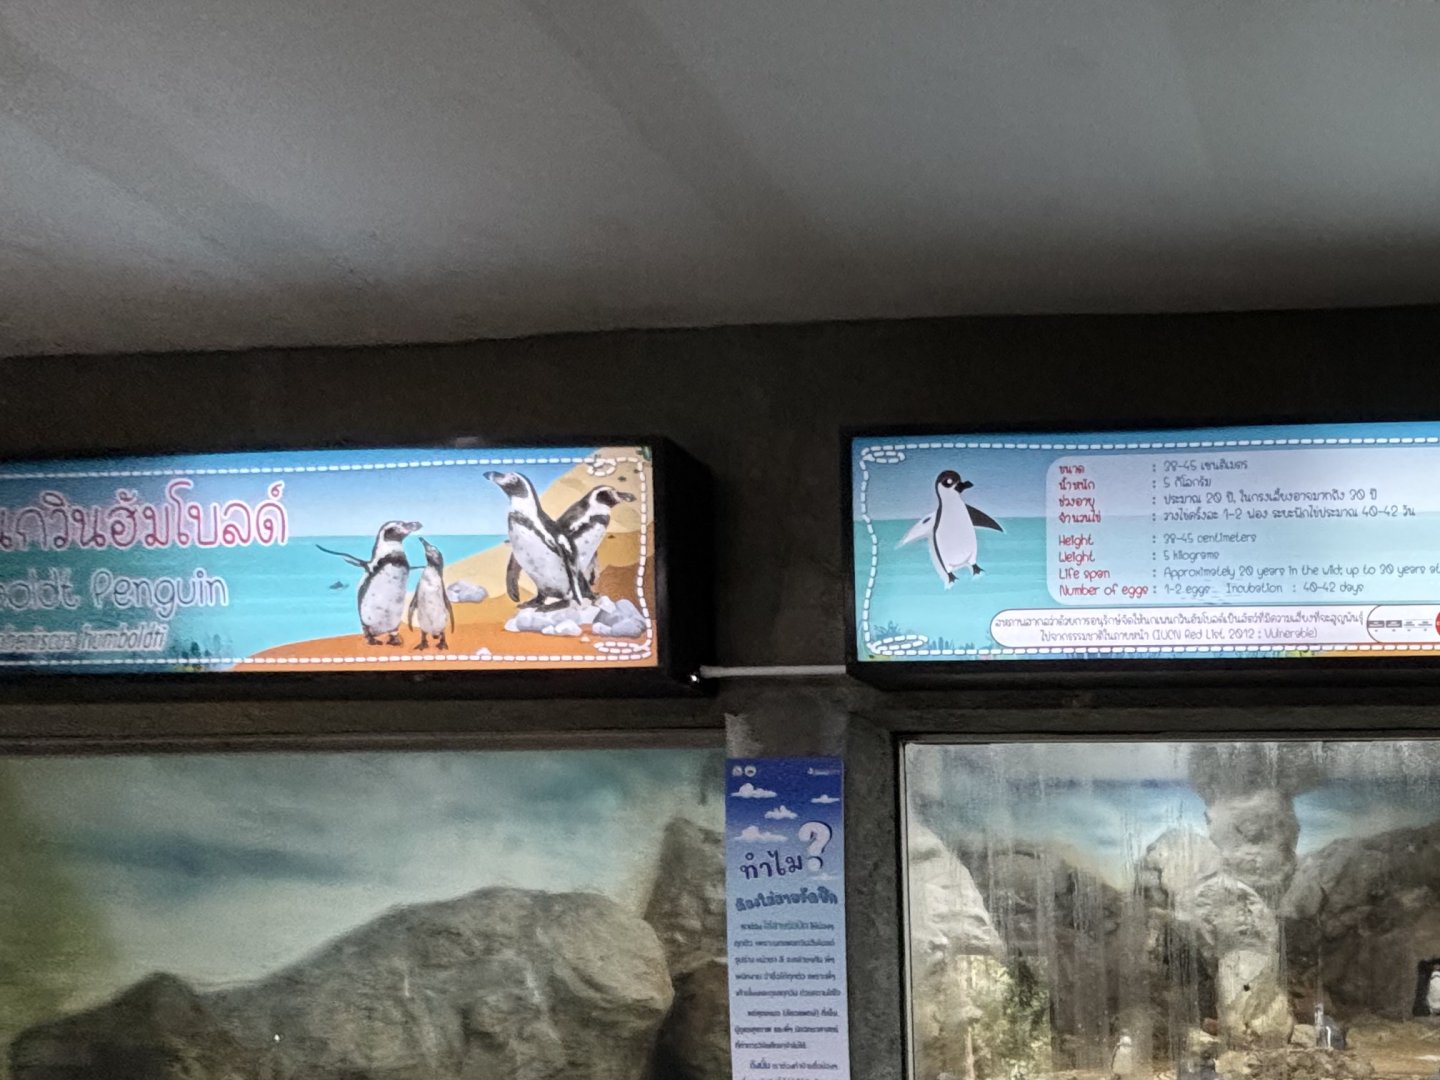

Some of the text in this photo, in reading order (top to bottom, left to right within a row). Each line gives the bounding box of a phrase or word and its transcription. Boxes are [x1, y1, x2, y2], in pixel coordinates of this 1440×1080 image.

[1163, 476, 1170, 488] 5
[1206, 492, 1222, 503] 20
[1224, 507, 1243, 519] 1-2
[1361, 505, 1398, 516] 40-42
[1058, 533, 1095, 549] Height
[1196, 531, 1257, 543] centimeters
[1058, 550, 1096, 566] Weight
[1163, 550, 1170, 562] 5
[1058, 567, 1080, 579] Life
[1083, 568, 1111, 582] span
[1163, 565, 1236, 580] Approximately
[1238, 565, 1254, 576] 20
[1256, 566, 1286, 580] years
[1287, 564, 1299, 576] in
[1301, 563, 1319, 576] the
[1345, 565, 1360, 580] up
[1362, 563, 1376, 575] to
[1396, 565, 1426, 580] years
[90, 567, 229, 619] Penguin
[1058, 585, 1101, 597] Number
[1103, 584, 1119, 597] of
[1121, 586, 1149, 600] eggs
[1185, 586, 1211, 600] eggs
[1225, 582, 1284, 595] Incubation
[1302, 582, 1337, 593] 40-42
[1339, 581, 1365, 596] days
[79, 622, 170, 650] humboldti
[1151, 628, 1182, 642] (IUCN
[1184, 628, 1203, 640] Red
[1229, 628, 1255, 641] 2012
[1264, 627, 1318, 640] Vulnerable)
